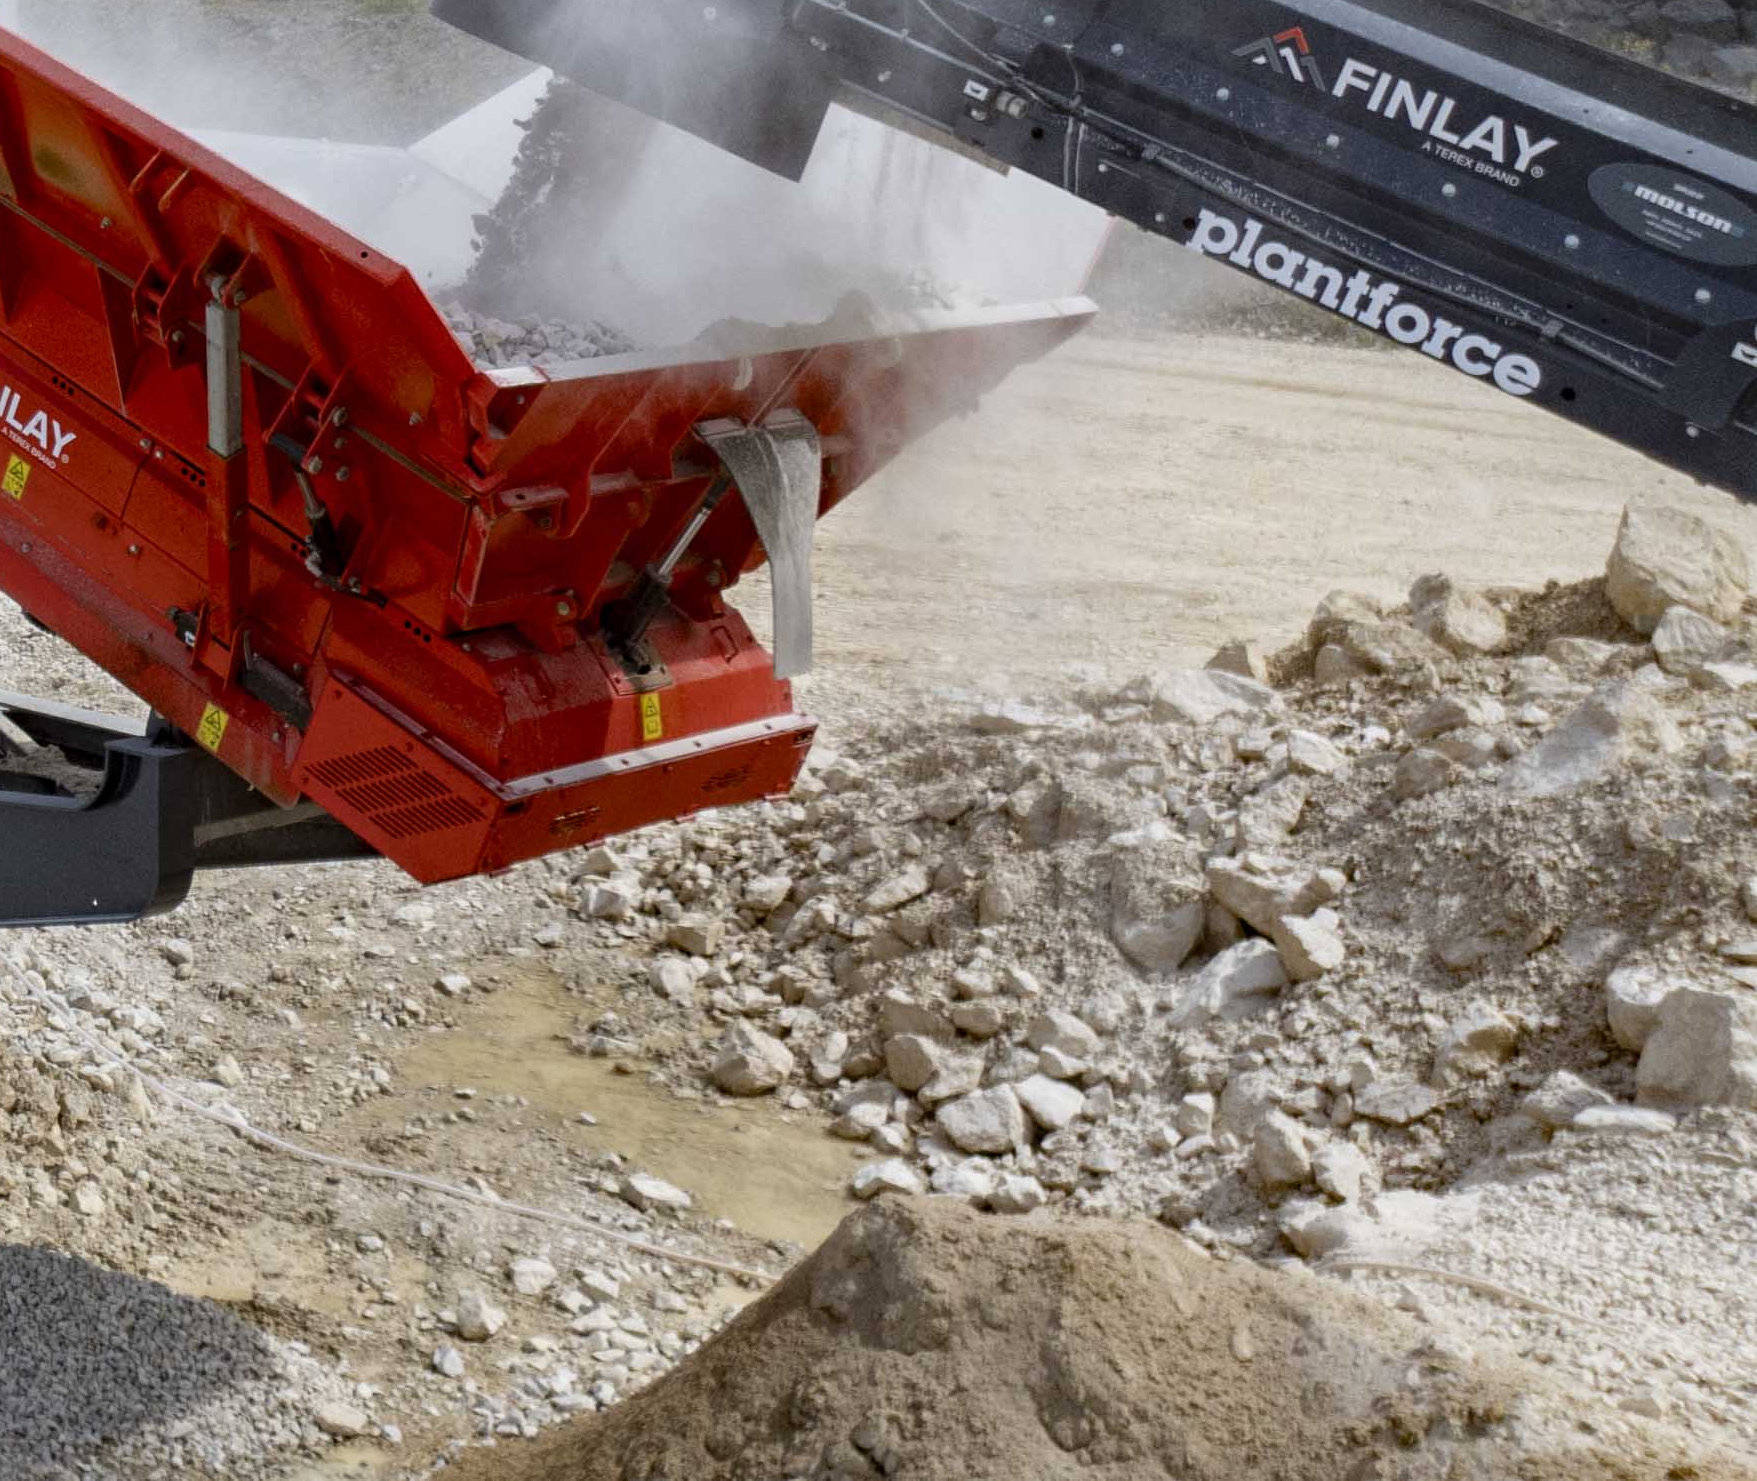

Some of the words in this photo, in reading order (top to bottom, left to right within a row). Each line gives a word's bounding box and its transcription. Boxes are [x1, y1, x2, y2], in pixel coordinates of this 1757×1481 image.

[1332, 57, 1559, 173] FINLAY
[1422, 141, 1432, 152] A
[1435, 146, 1473, 169] TEREX
[1474, 162, 1520, 187] BRAND
[1185, 208, 1540, 396] plantforce
